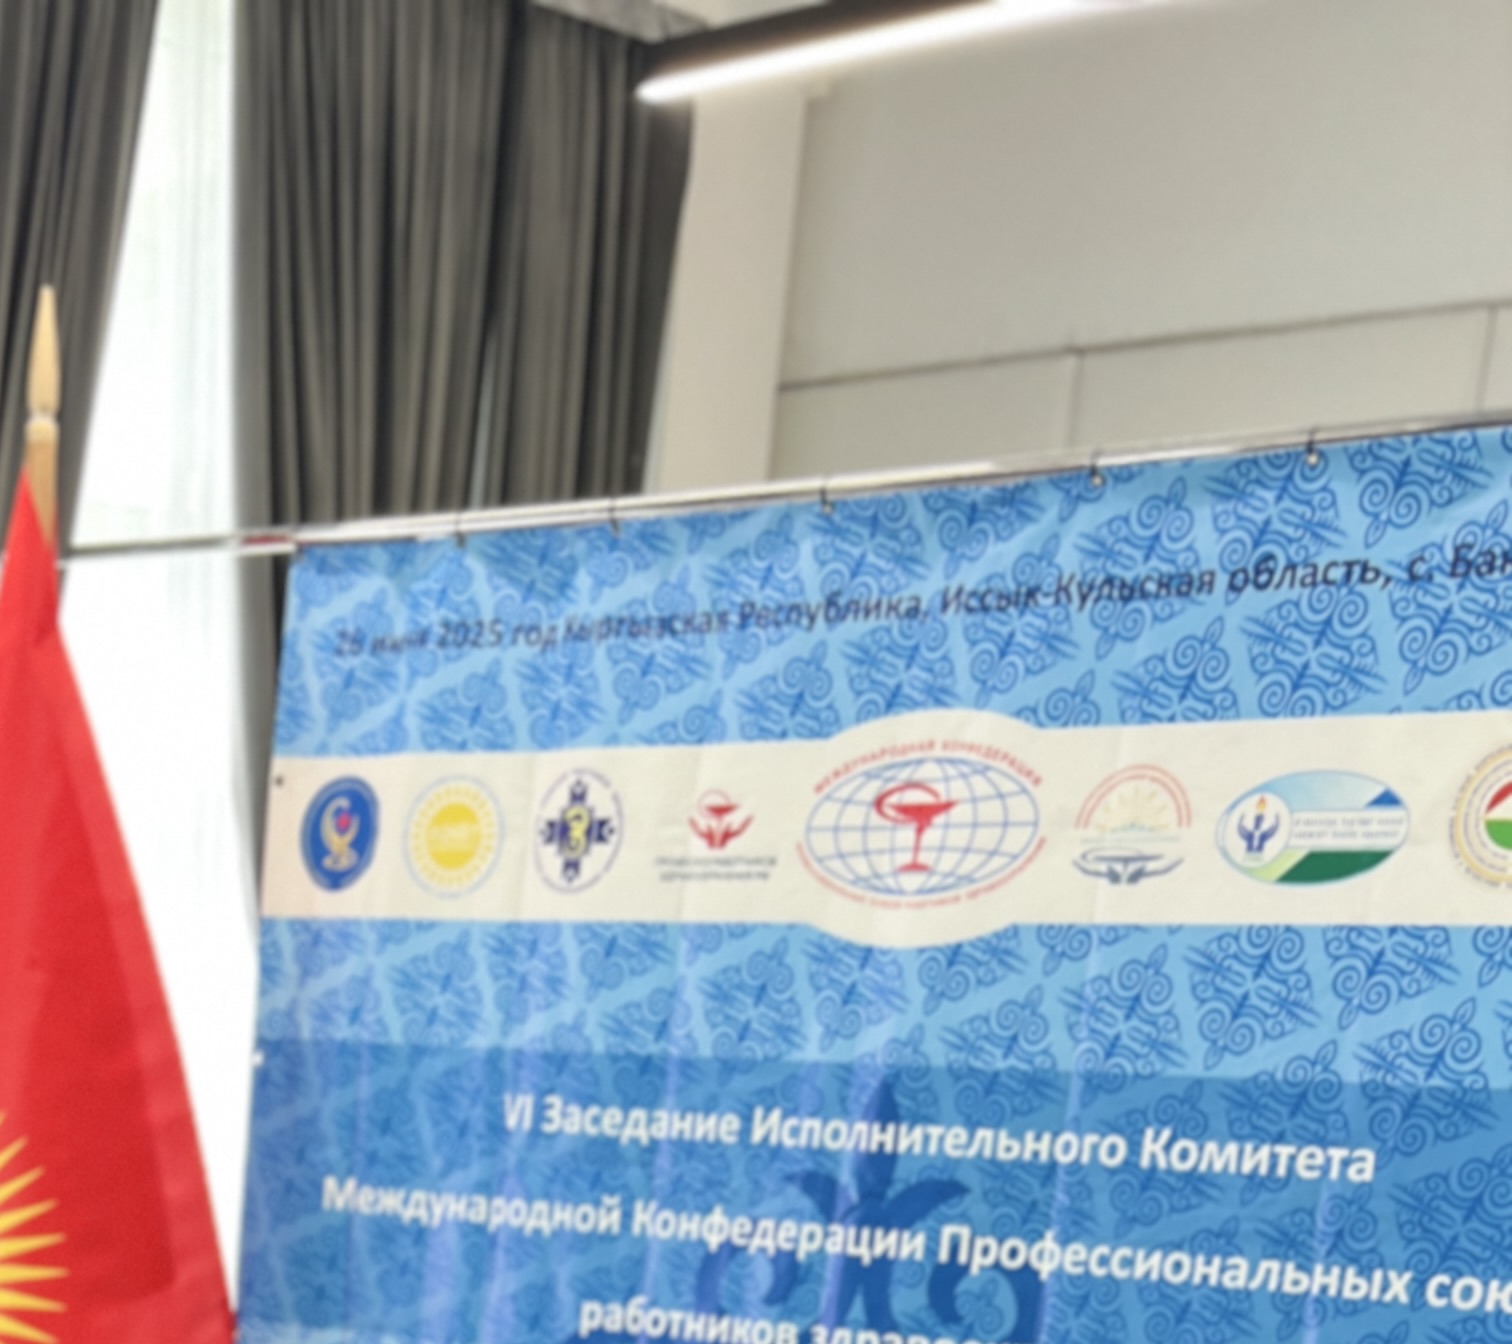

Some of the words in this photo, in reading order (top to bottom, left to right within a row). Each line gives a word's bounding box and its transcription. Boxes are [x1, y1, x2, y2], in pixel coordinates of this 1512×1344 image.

[436, 617, 503, 650] 2025
[562, 608, 730, 644] Кыргызская
[941, 567, 1216, 615] Иссык-Кульская
[1229, 553, 1391, 592] область,
[1409, 555, 1434, 583] с.
[504, 1093, 533, 1131] VI
[541, 1095, 741, 1146] Заседание
[751, 1106, 1127, 1168] Исполнительного
[1139, 1127, 1376, 1183] Комитета
[321, 1174, 623, 1237] Международной
[632, 1199, 927, 1267] Конфедерации
[937, 1222, 1414, 1305] Профессиональных
